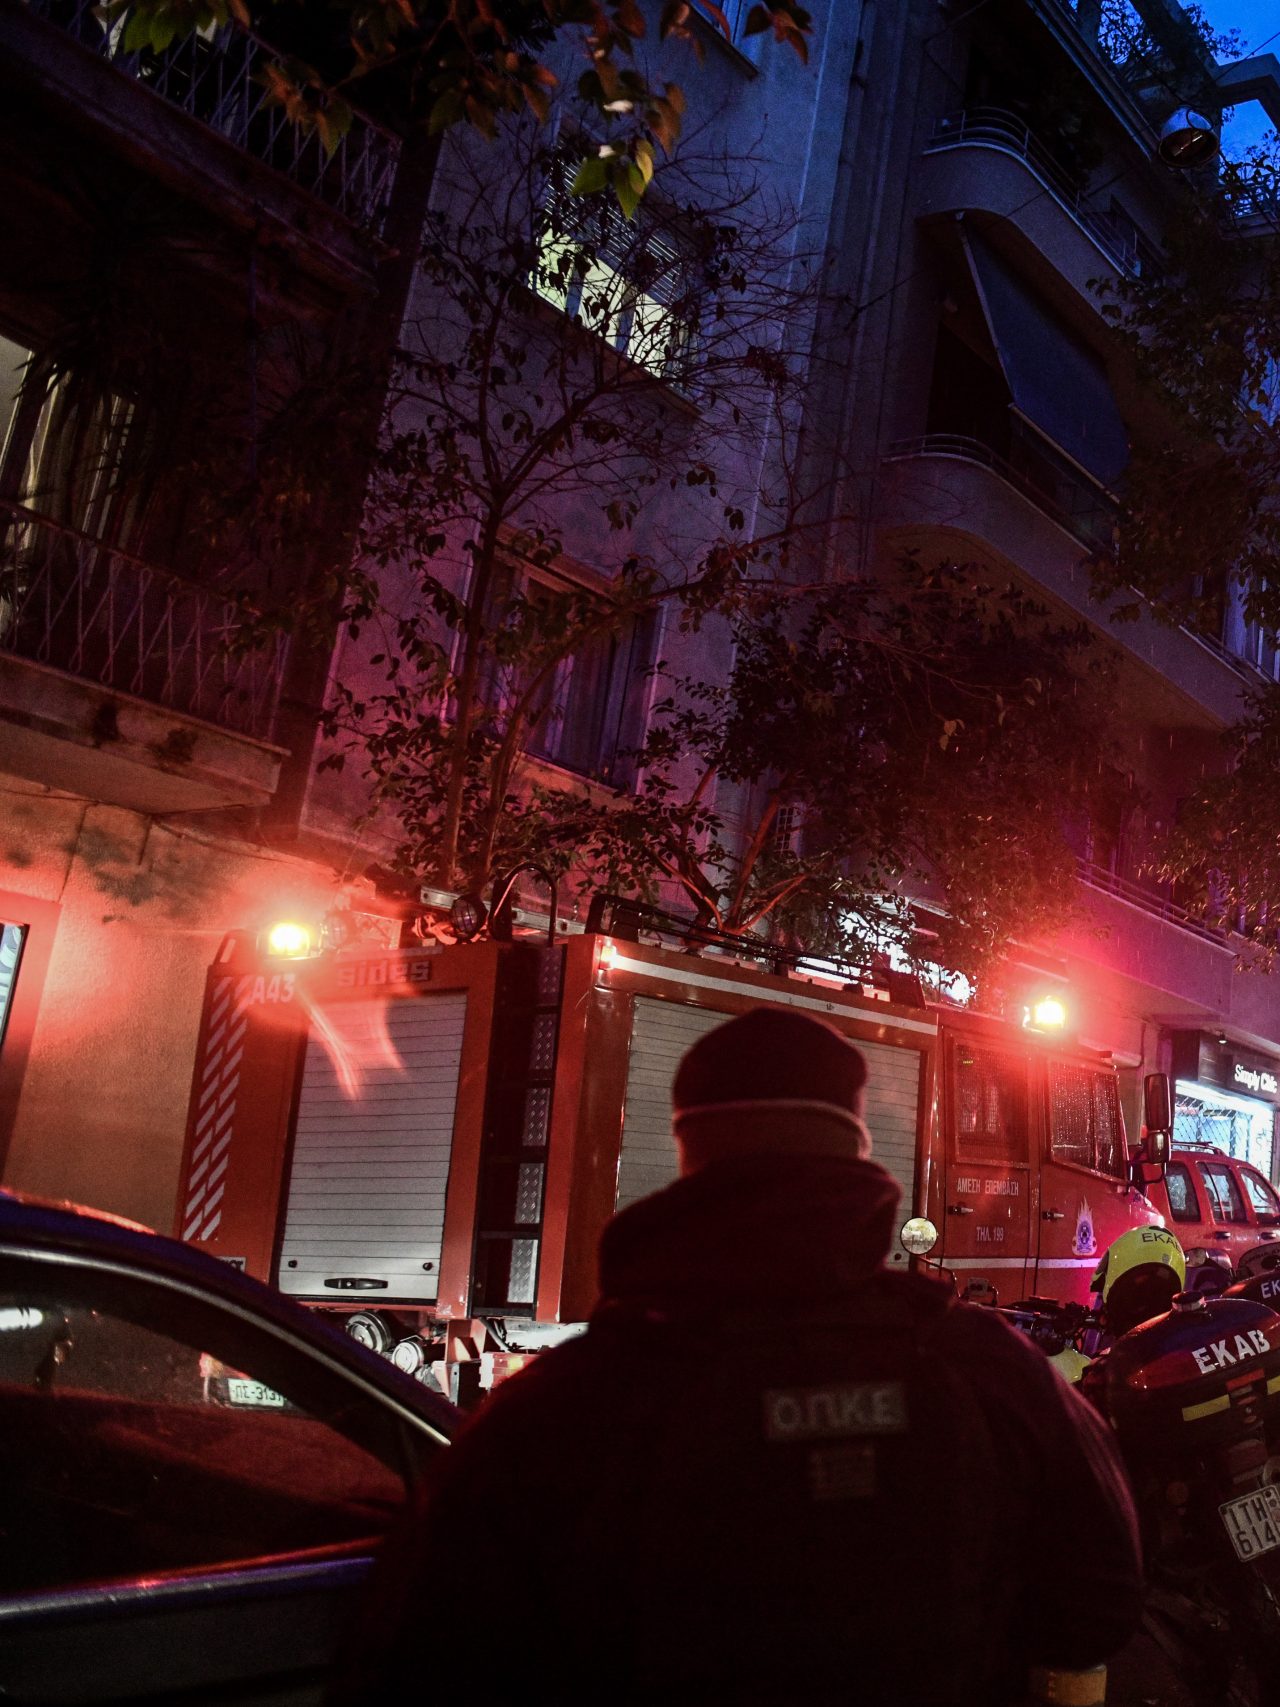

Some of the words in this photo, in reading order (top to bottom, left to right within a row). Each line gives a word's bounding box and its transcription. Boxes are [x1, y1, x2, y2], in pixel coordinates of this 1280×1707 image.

[1234, 1064, 1260, 1091] Simply
[1260, 1072, 1278, 1094] Chic
[957, 1177, 981, 1194] ΑΜΕΣΗ
[985, 1179, 1019, 1196] ΕΠΕΜΒΑΣΗ
[993, 1227, 1004, 1241] 199
[1237, 1521, 1277, 1554] 614
